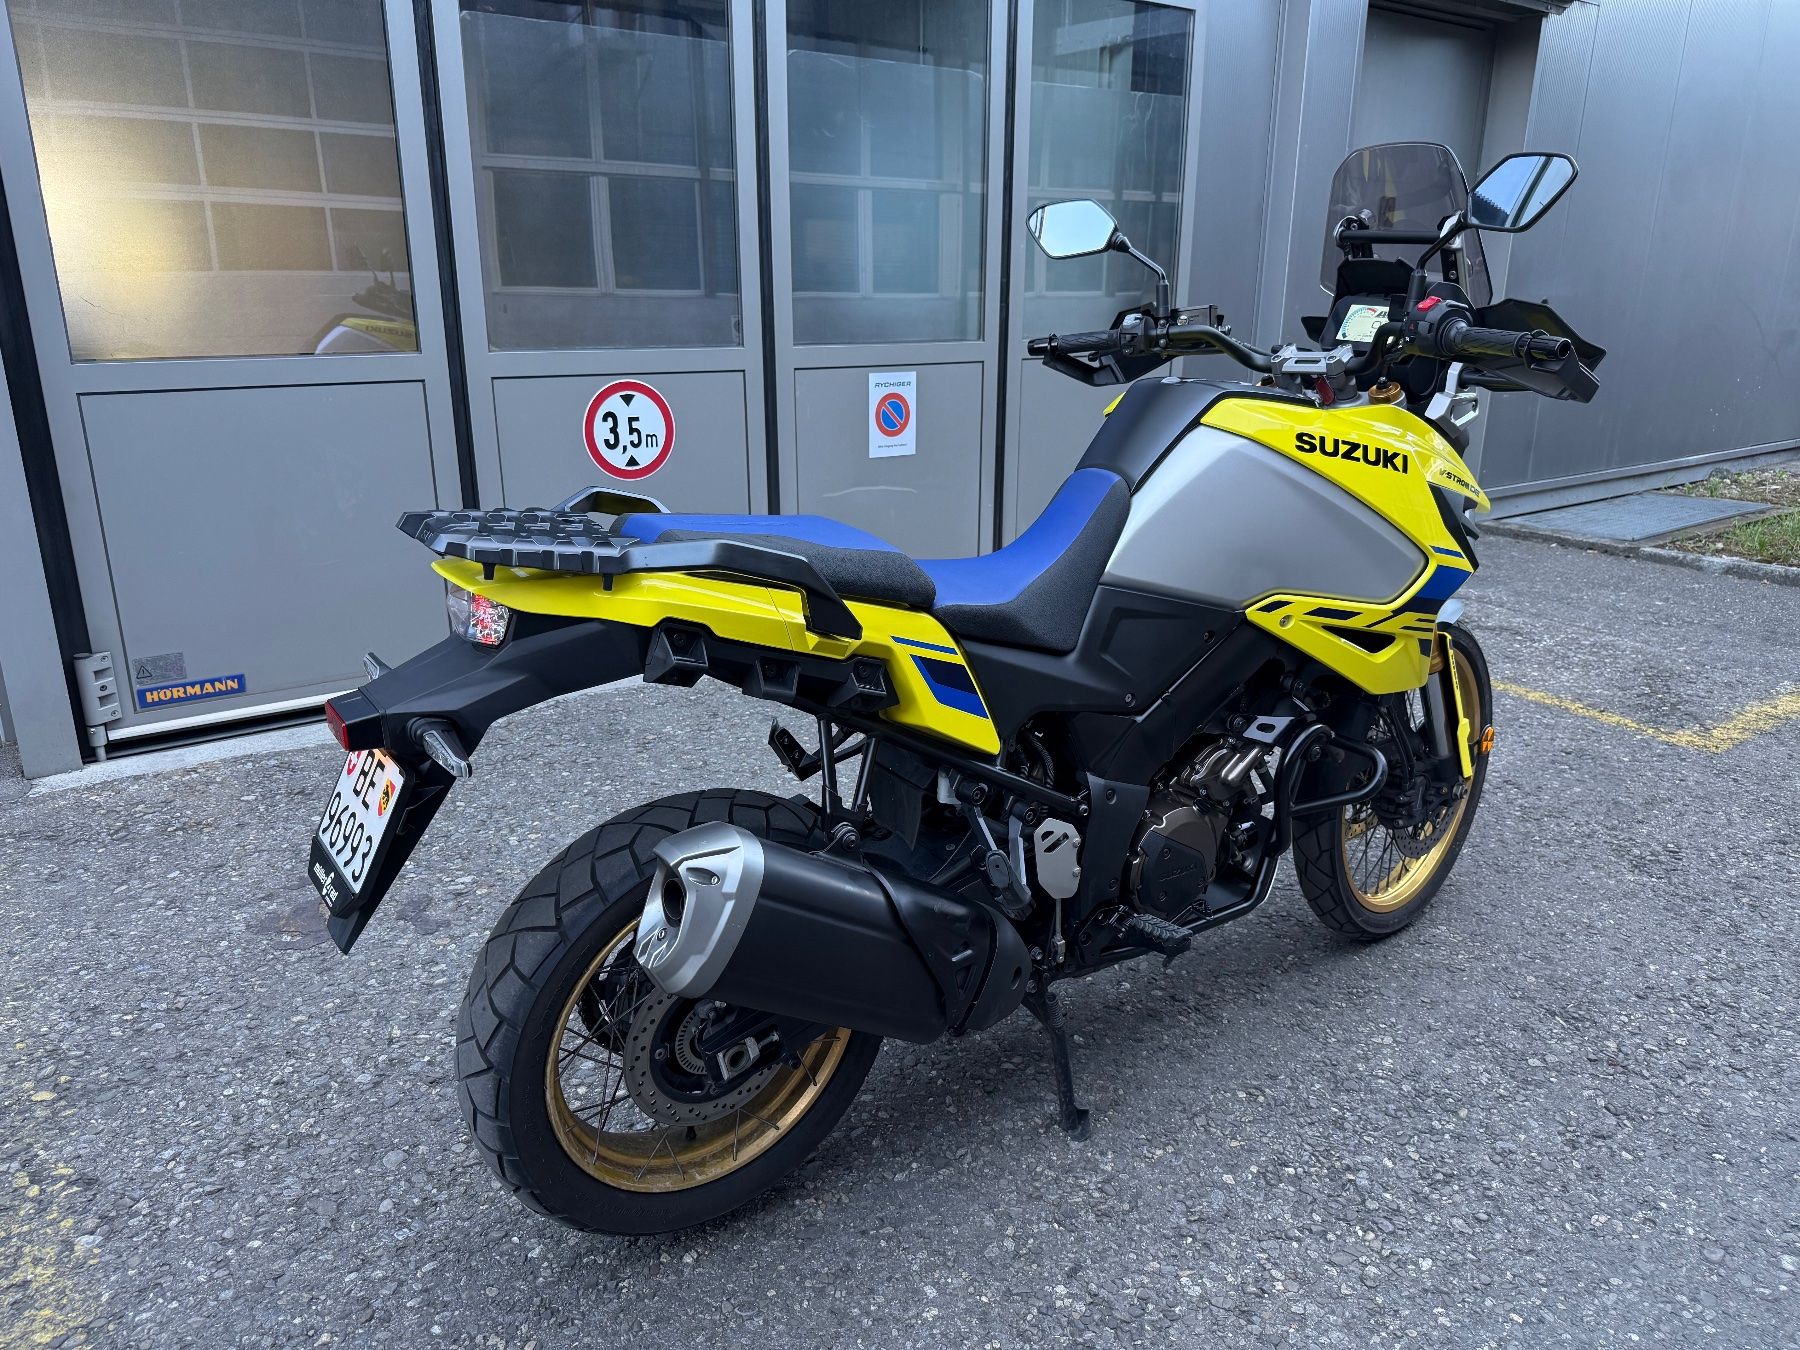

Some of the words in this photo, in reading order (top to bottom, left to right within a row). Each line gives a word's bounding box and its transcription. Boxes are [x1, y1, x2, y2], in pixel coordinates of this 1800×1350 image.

[874, 380, 912, 389] RYCHIGER
[601, 410, 643, 455] 3,5
[645, 430, 659, 448] m
[1295, 432, 1409, 475] SUZUKI
[145, 678, 239, 703] HÖRMANN
[352, 749, 386, 811] BE
[322, 791, 373, 883] 96993
